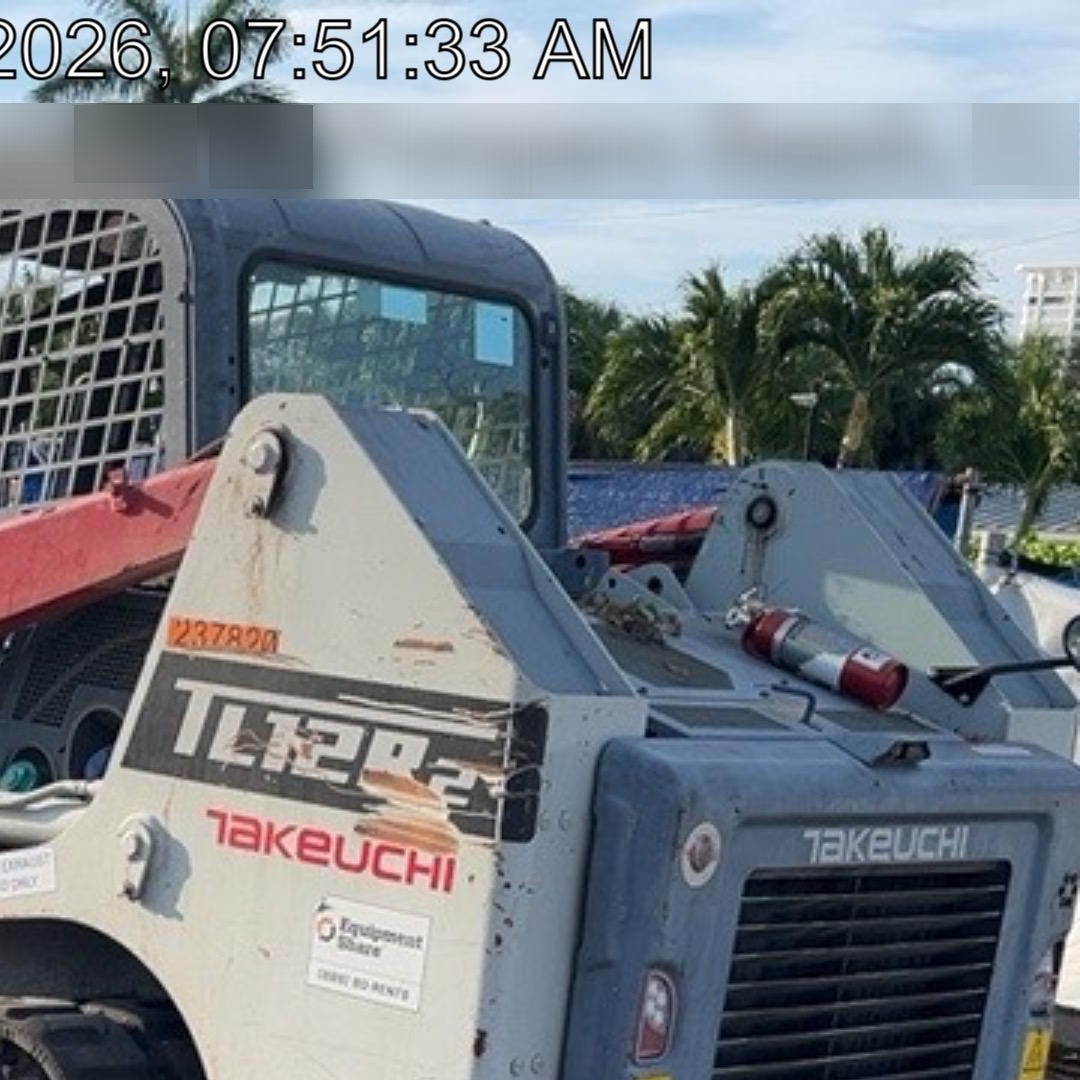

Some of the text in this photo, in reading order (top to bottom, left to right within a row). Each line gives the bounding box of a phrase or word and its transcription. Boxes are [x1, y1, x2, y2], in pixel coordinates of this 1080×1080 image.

[206, 810, 456, 893] TAKEUCHI
[803, 826, 969, 864] TAKEUCHI
[337, 935, 382, 958] Share
[339, 916, 423, 949] Equipment
